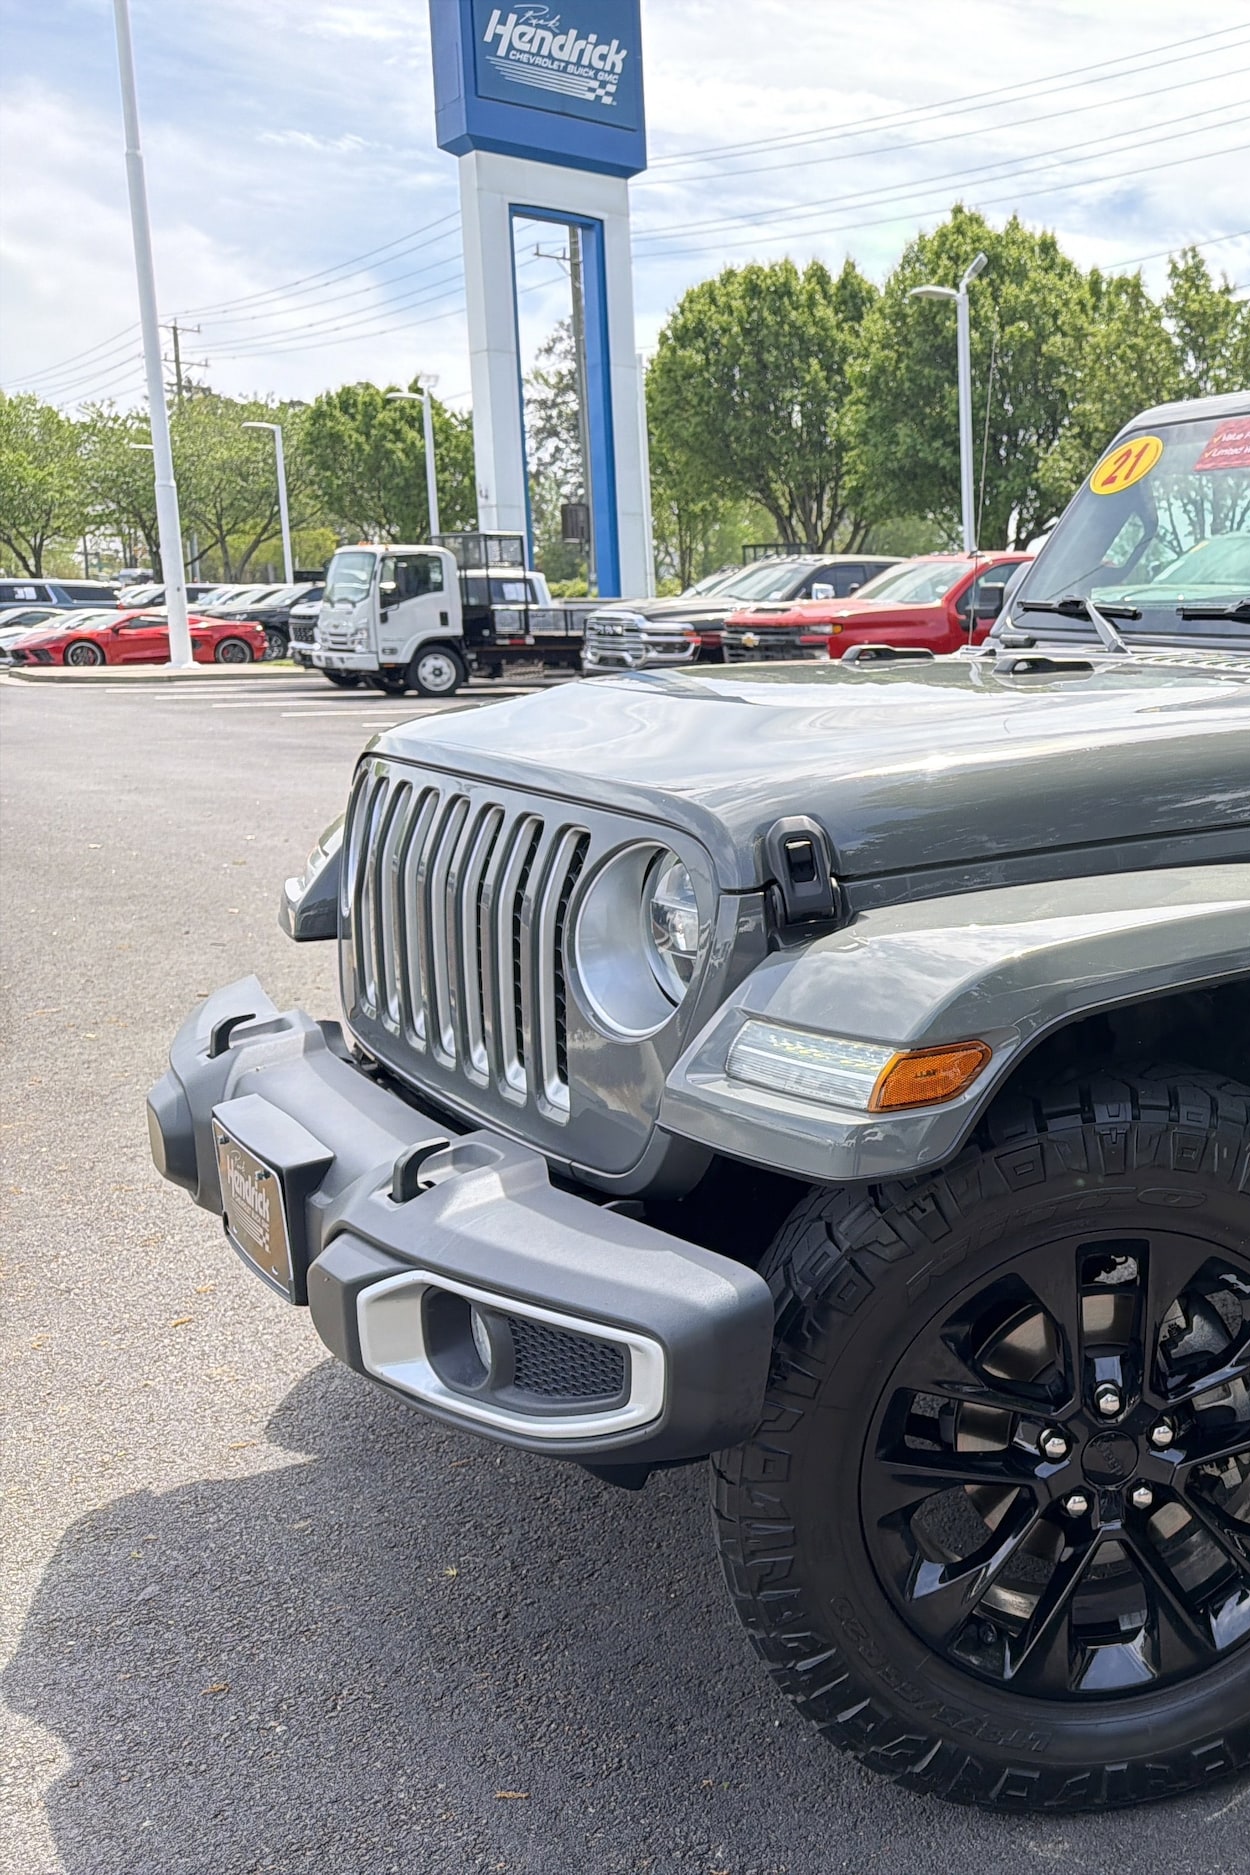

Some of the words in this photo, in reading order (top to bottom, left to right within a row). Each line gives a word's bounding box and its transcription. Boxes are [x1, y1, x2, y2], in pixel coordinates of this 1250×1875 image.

[483, 9, 627, 74] Hendrick
[509, 50, 565, 71] CHEVROLET
[567, 64, 595, 78] BUICK
[597, 71, 619, 84] GMC
[1101, 442, 1150, 487] 21
[227, 1154, 270, 1223] Hendrick
